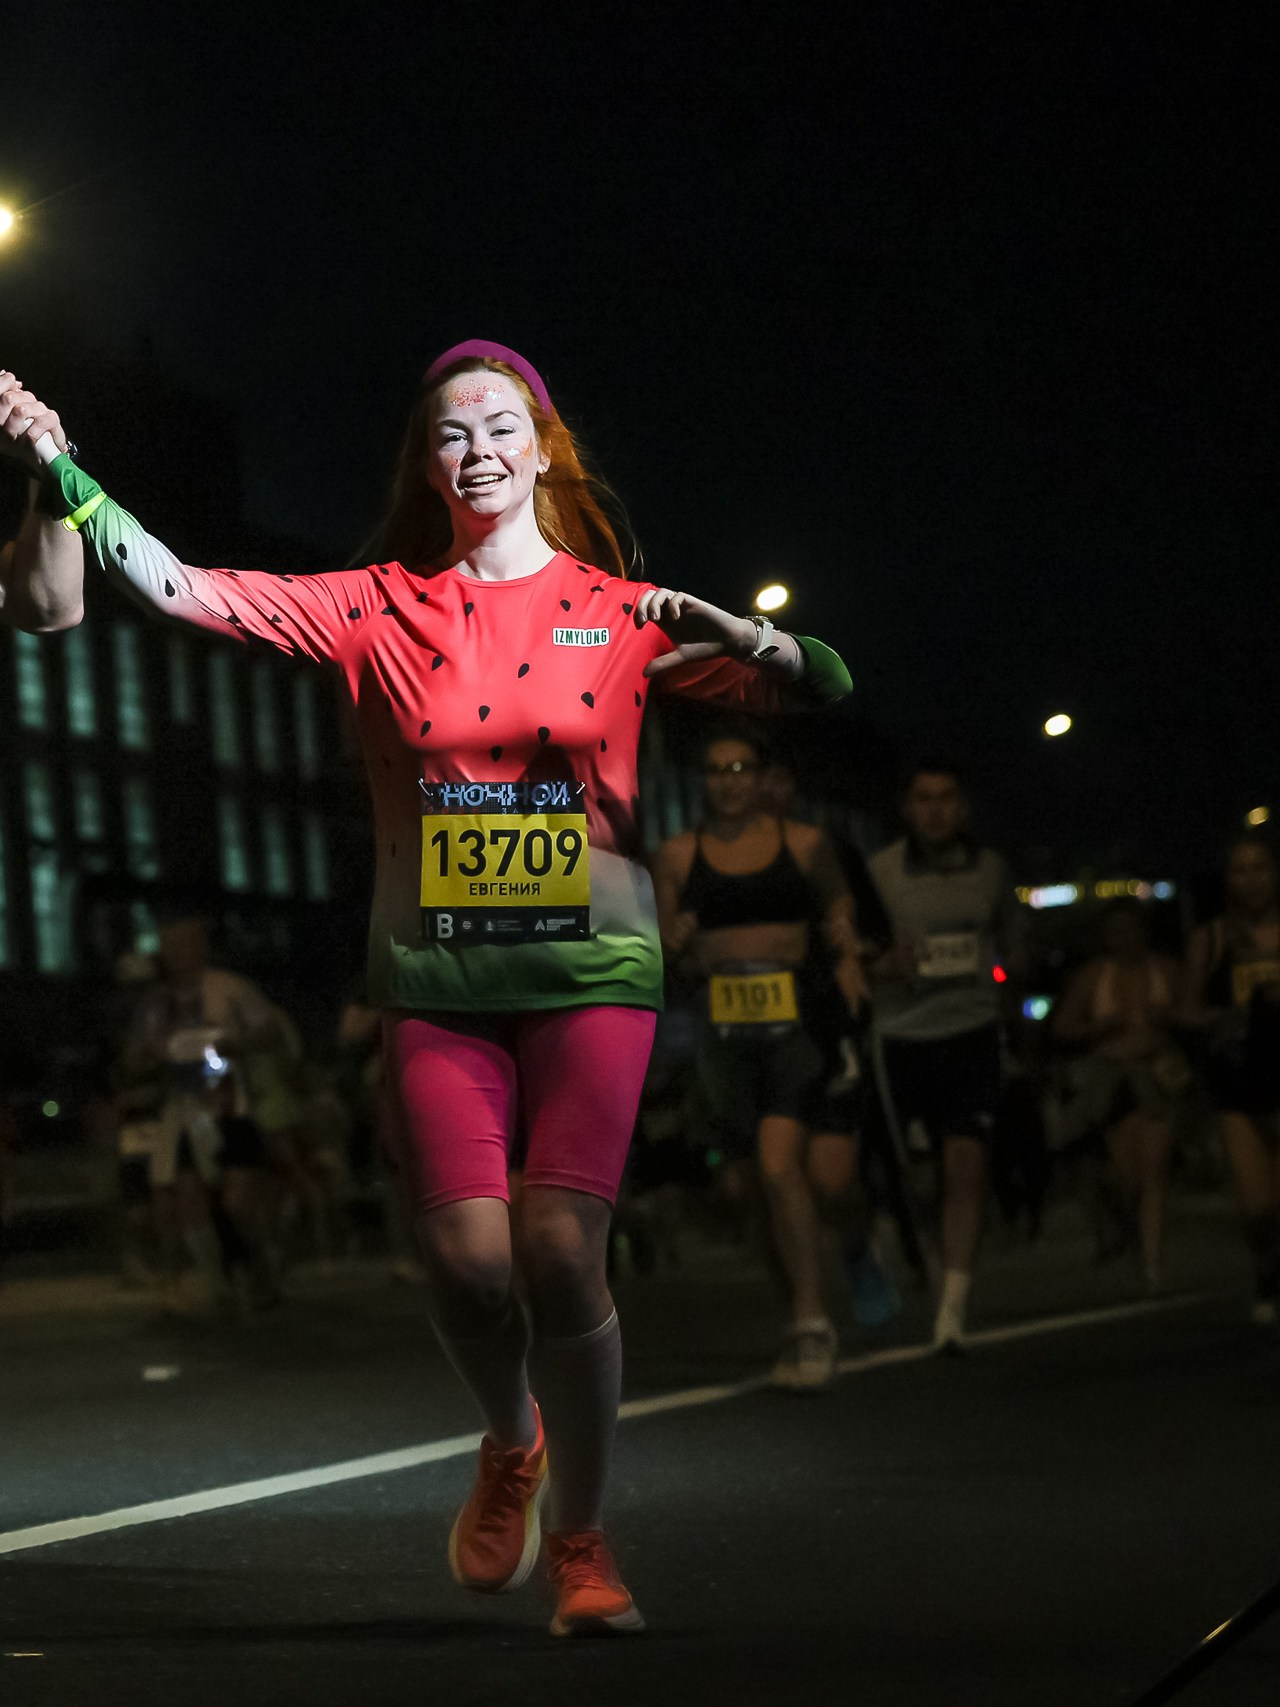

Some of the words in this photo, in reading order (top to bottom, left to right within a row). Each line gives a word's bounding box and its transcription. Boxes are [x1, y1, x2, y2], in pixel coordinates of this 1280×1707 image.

[555, 629, 607, 645] IZMYLONG
[431, 828, 583, 878] 13709
[469, 882, 541, 896] ЕВГЕНИЯ
